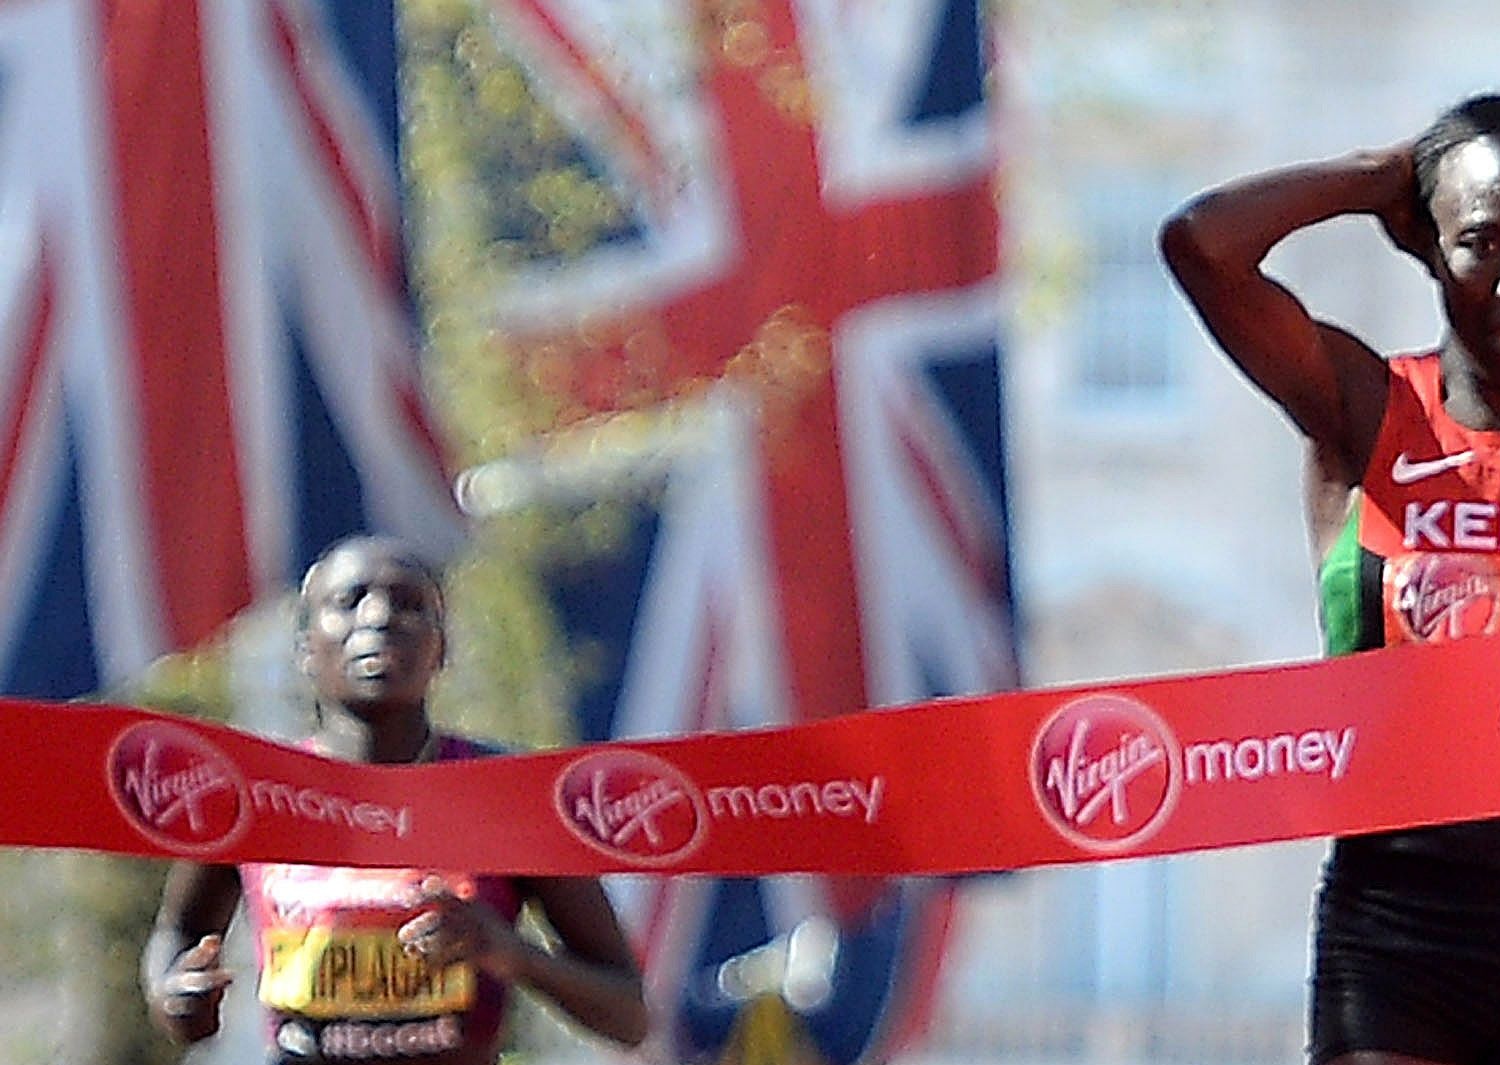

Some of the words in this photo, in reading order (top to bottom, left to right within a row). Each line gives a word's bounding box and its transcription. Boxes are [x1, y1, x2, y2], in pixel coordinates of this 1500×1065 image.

[124, 739, 230, 832] Virgin
[250, 779, 411, 838] money
[574, 770, 684, 848] Virgin
[706, 775, 886, 823] money
[1046, 718, 1163, 826] Virgin
[1184, 726, 1357, 784] money
